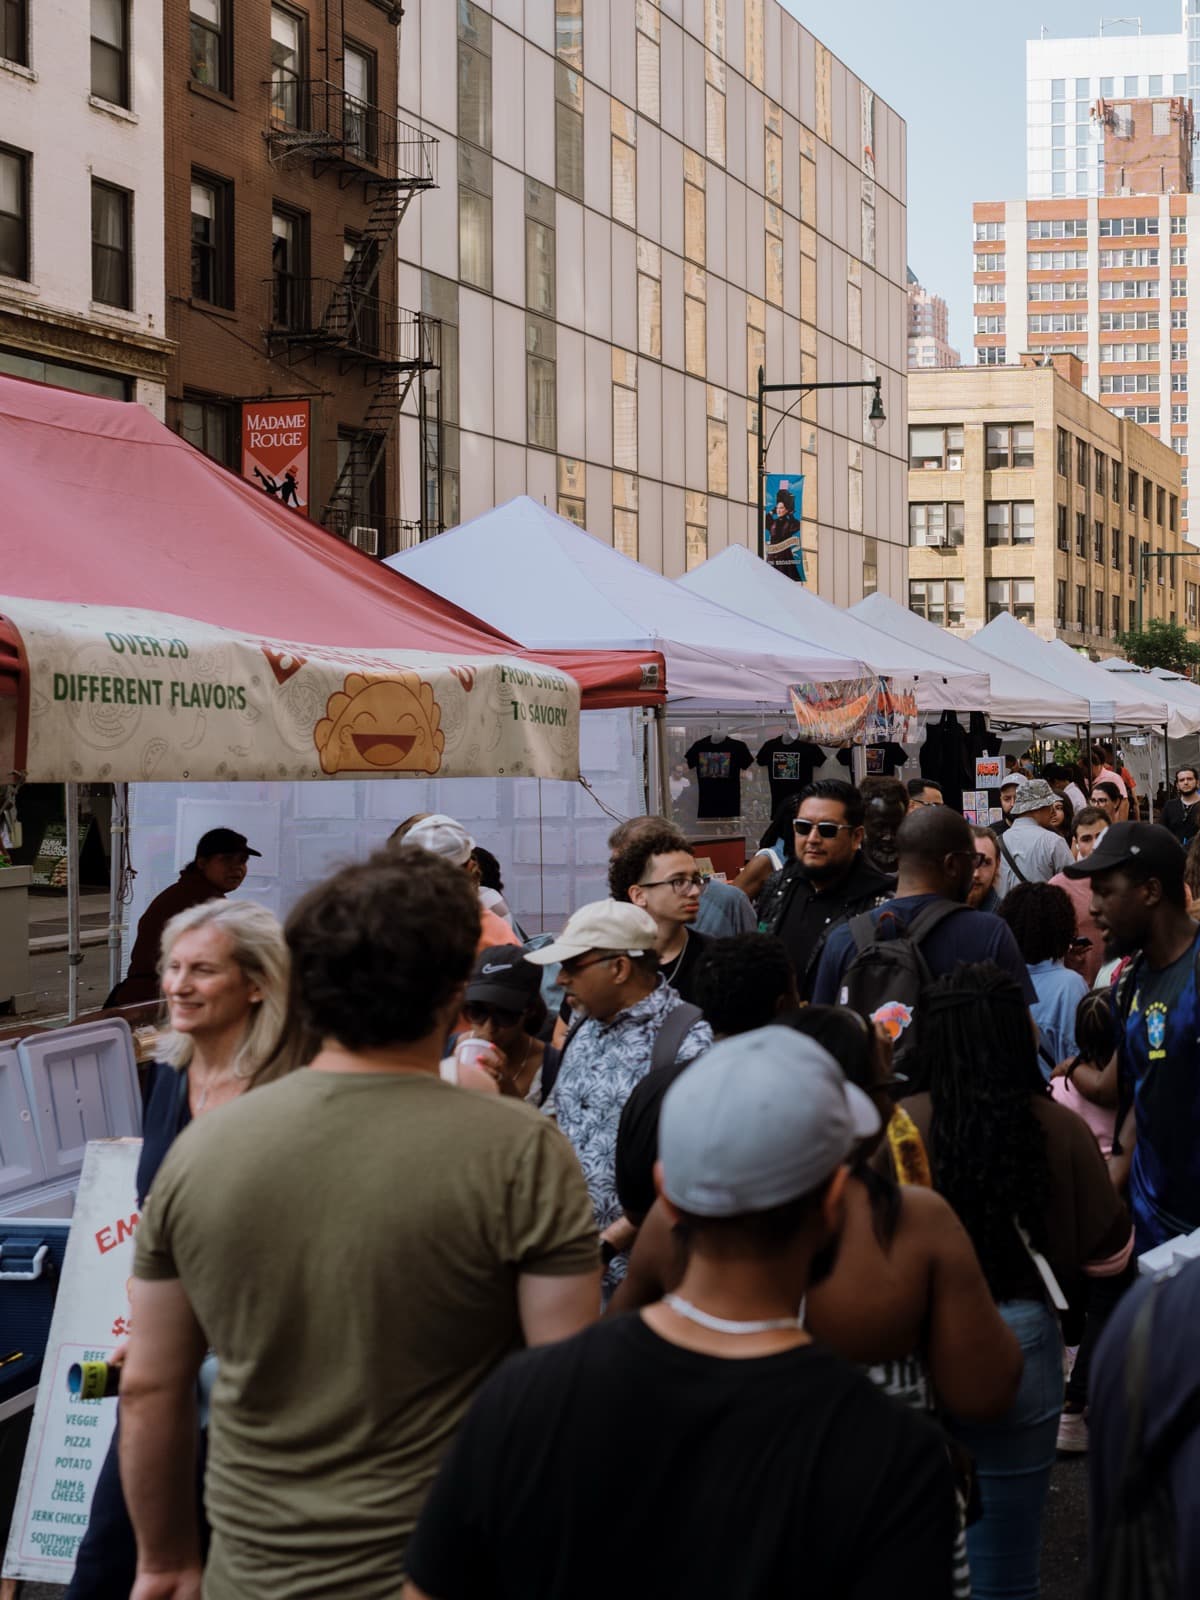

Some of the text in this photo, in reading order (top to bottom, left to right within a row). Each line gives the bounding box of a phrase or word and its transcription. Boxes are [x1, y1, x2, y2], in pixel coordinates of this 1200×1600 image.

[247, 414, 305, 430] MADAME
[250, 432, 302, 448] ROUGE
[105, 631, 189, 659] OVER 20
[501, 665, 568, 692] FROM SWEET
[53, 673, 246, 710] DIFFERENT FLAVORS
[511, 701, 567, 727] TO SAVORY
[95, 1214, 140, 1254] EM
[83, 1351, 105, 1362] BEEF
[66, 1414, 99, 1427] VEGGIE
[64, 1435, 91, 1448] PIZZA
[55, 1456, 93, 1471] POTATO
[55, 1479, 85, 1492] HAM &
[51, 1491, 86, 1503] CHEESE
[31, 1510, 89, 1526] JERK CHICKE
[30, 1531, 82, 1546] SOUTHWES
[40, 1545, 73, 1558] VEGGIE
